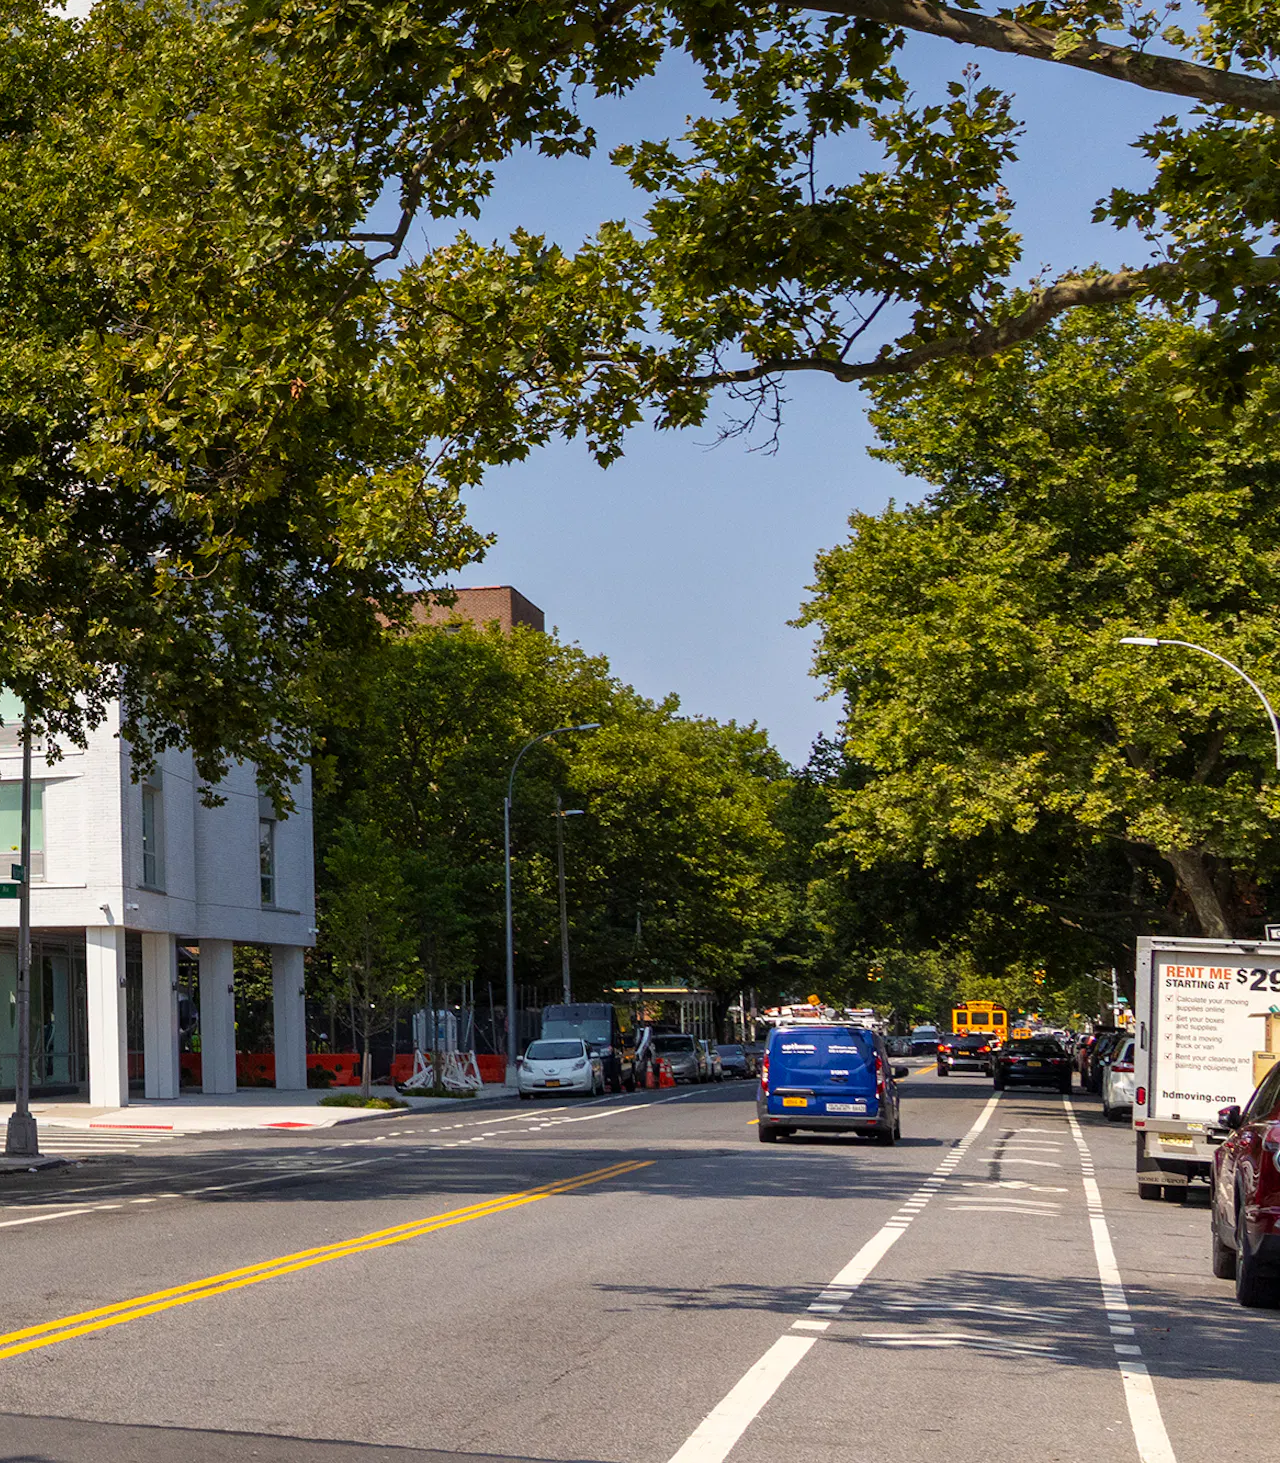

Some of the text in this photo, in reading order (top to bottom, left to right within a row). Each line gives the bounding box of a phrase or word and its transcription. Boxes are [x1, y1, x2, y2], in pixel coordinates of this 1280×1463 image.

[1166, 965, 1204, 979] RENT
[1210, 968, 1232, 980] ME
[1165, 979, 1230, 990] STARTING AT
[1176, 996, 1207, 1004] Calculate
[1225, 999, 1249, 1007] moving
[1176, 1005, 1203, 1013] supplies
[1190, 1024, 1217, 1032] supplies
[1175, 1033, 1191, 1041] Rent
[1199, 1035, 1223, 1044] moving
[1208, 1055, 1236, 1064] cleaning
[1175, 1063, 1238, 1072] painting equipment
[1162, 1090, 1236, 1103] hdmoving.com
